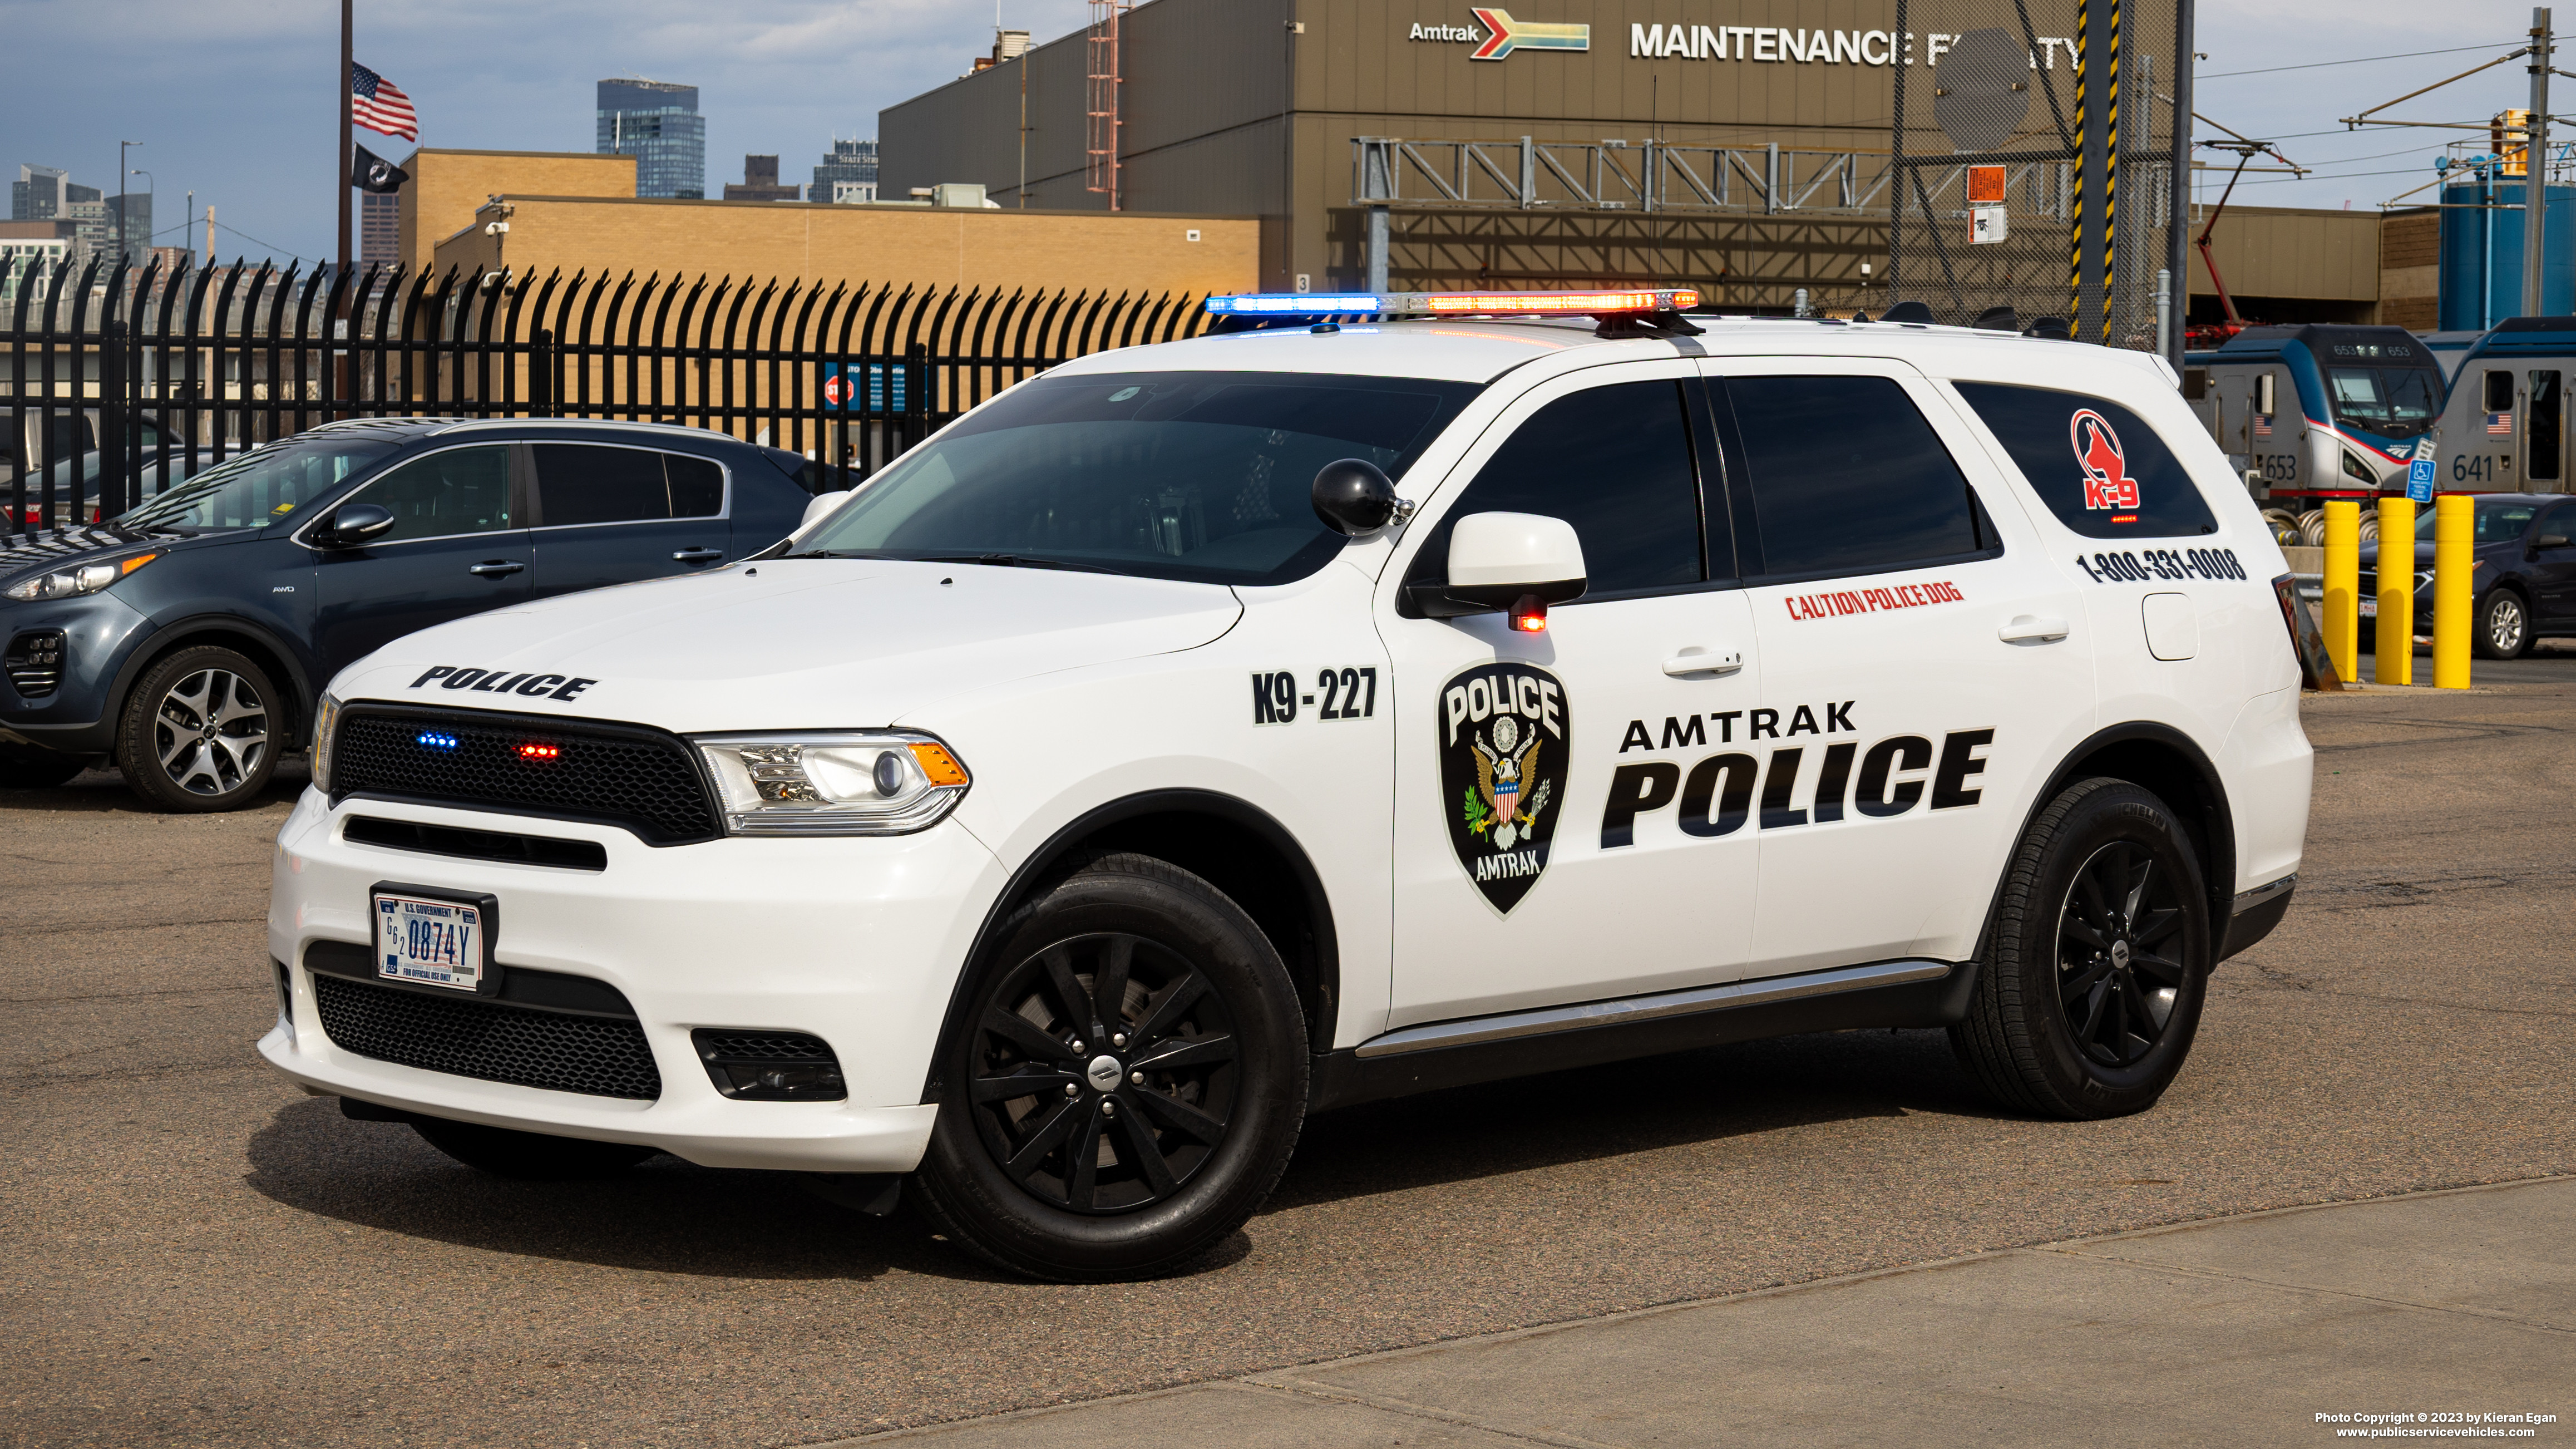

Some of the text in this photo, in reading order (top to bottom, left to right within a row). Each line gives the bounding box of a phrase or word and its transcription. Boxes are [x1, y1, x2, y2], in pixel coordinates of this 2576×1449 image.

[1409, 22, 1479, 42] Amtrak
[1631, 23, 1913, 65] MAINTENANCE
[1299, 277, 1306, 290] 3
[2334, 345, 2356, 356] 653
[2387, 346, 2411, 357] 653
[2267, 454, 2296, 480] 653
[2453, 454, 2492, 481] 641
[2083, 477, 2140, 510] K-9
[2076, 548, 2248, 583] 1-800-331-0008
[1785, 580, 1965, 620] CAUTION POLICE DOG
[408, 666, 599, 702] POLICE
[1251, 667, 1376, 724] K9-227
[1446, 674, 1561, 747] POLICE
[205, 727, 216, 738] KIA
[1618, 700, 1857, 754] AMTRAK
[1517, 741, 1529, 756] UNUM
[1600, 726, 1996, 850] POLICE
[1476, 850, 1541, 881] AMTRAK
[404, 903, 451, 918] U.S. GOVERNMENT
[408, 919, 469, 966] 0874Y
[403, 968, 411, 976] FOR
[412, 969, 430, 978] OFFICIAL
[431, 972, 440, 980] USE
[440, 973, 451, 982] ONLY
